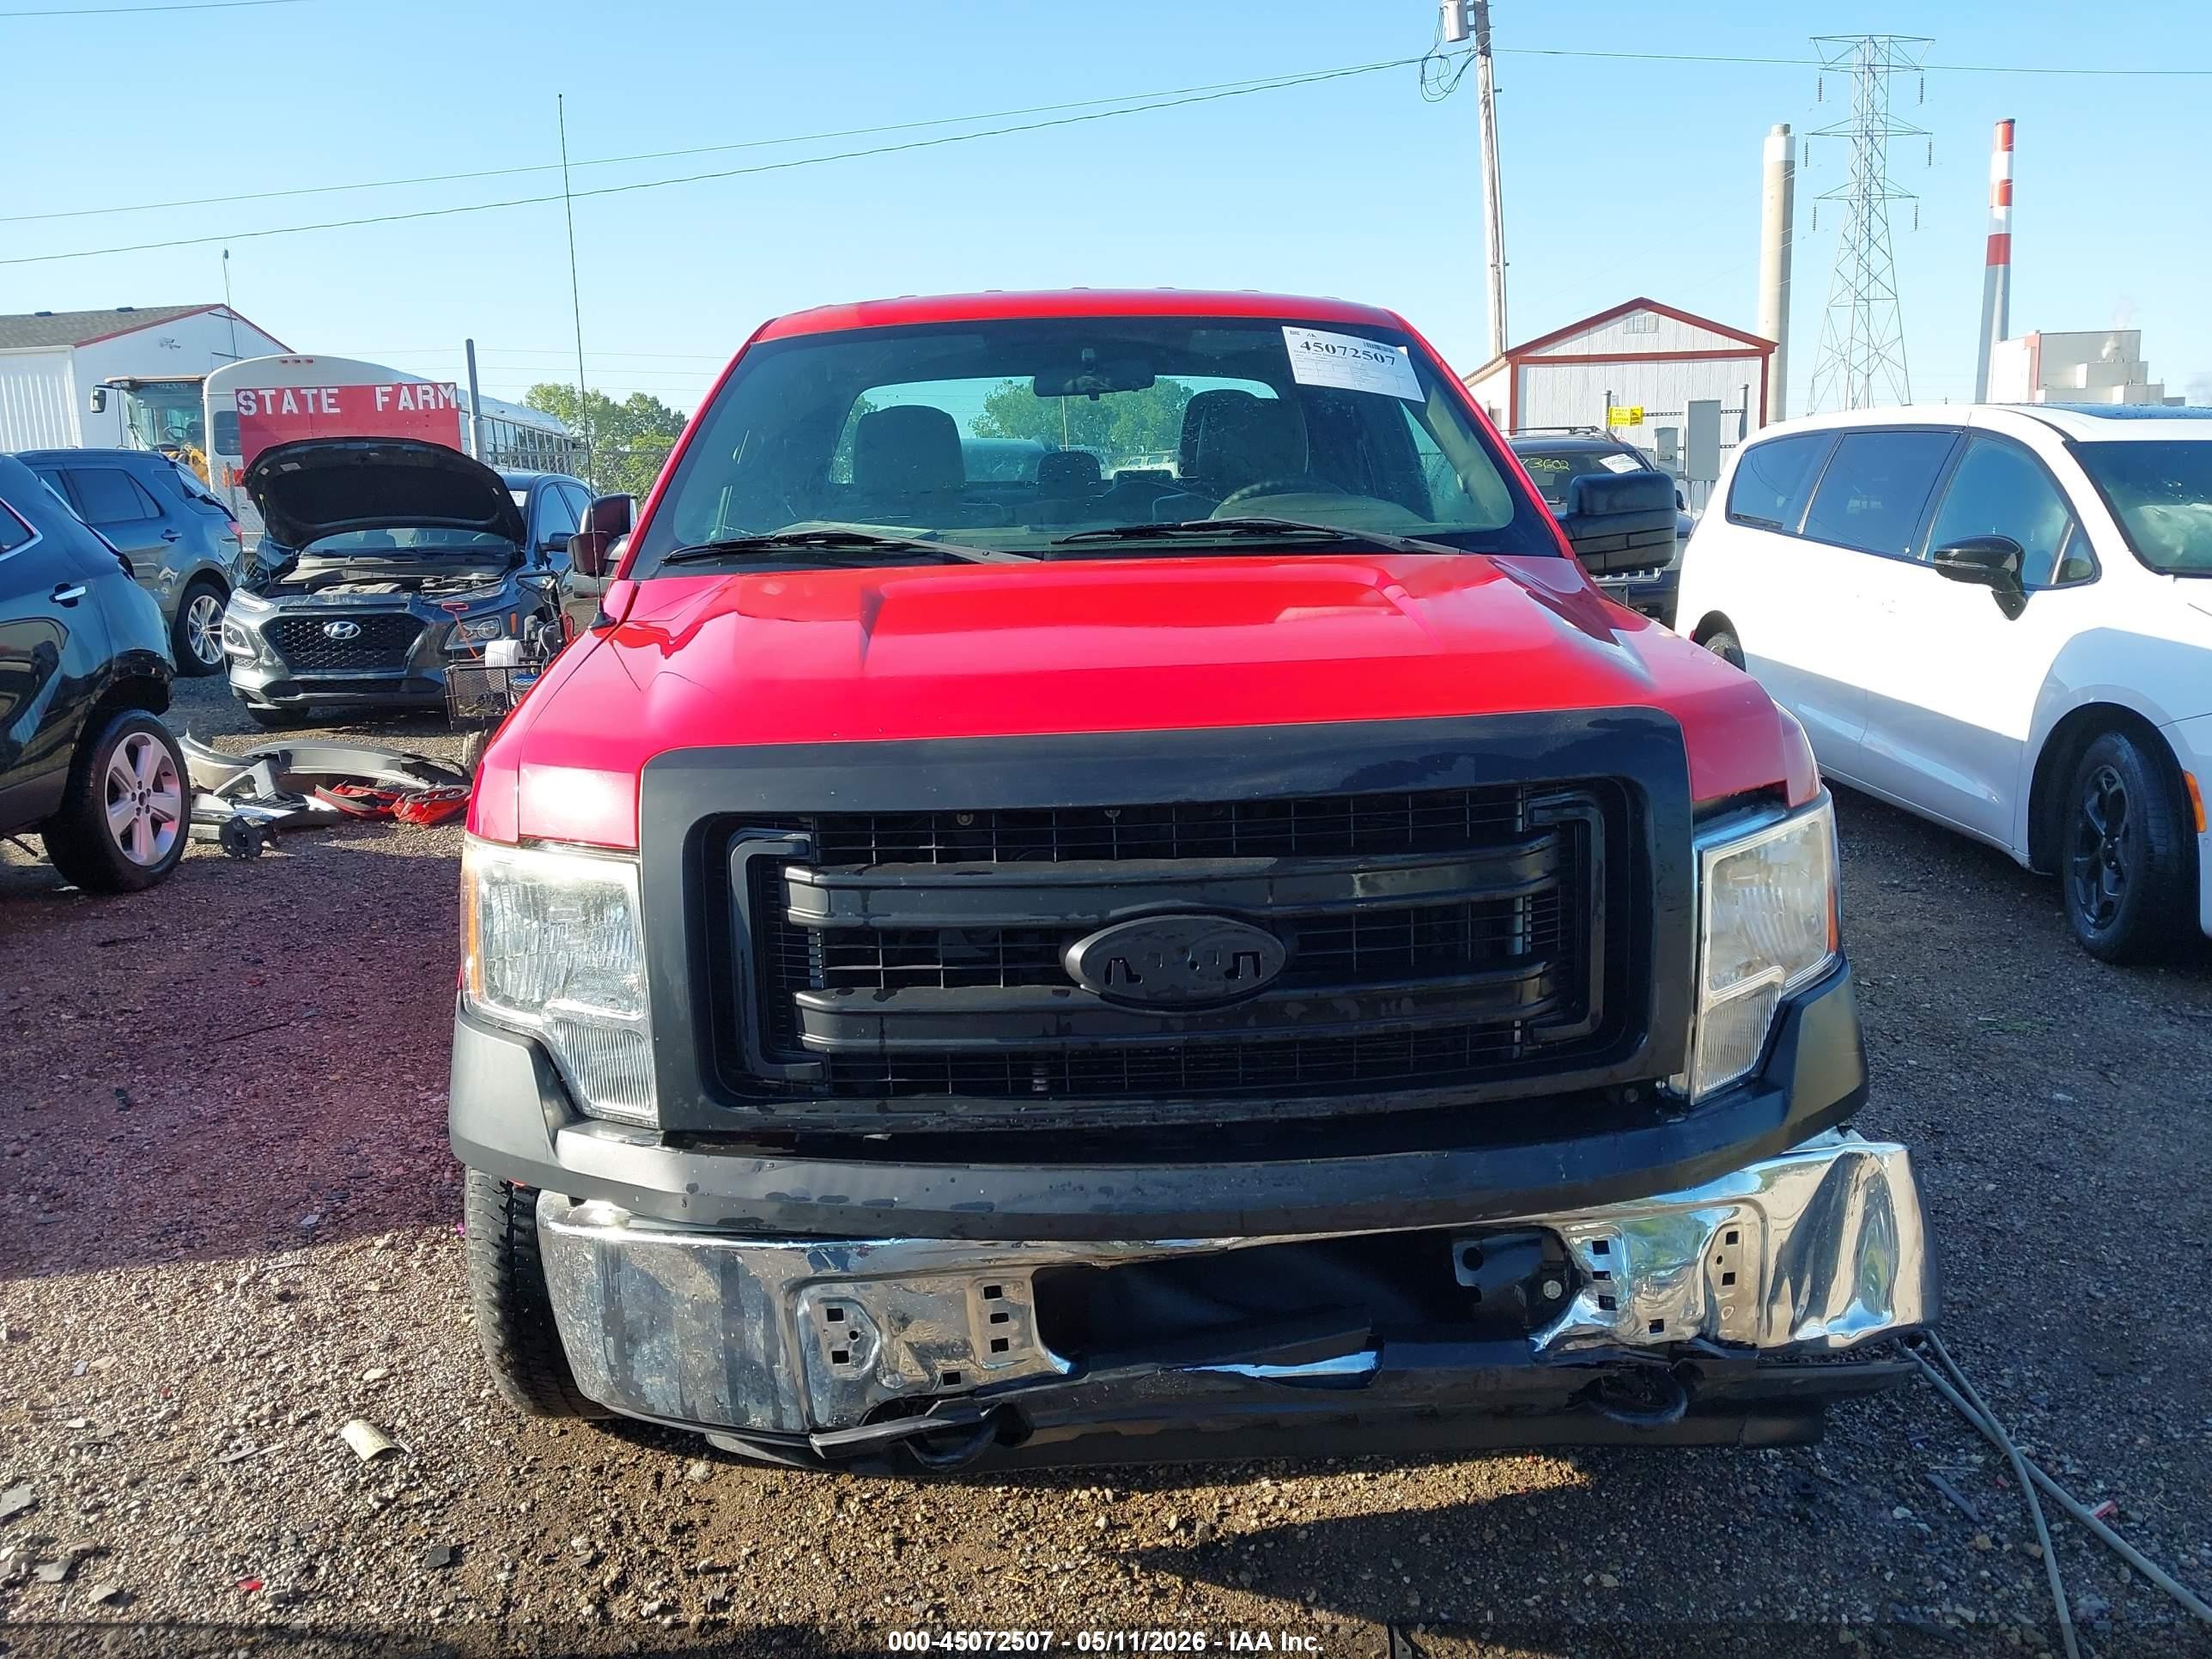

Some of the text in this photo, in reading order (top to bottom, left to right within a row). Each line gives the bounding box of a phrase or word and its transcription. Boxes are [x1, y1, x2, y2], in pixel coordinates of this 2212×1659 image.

[1299, 341, 1395, 366] 45072507
[237, 384, 457, 416] STATE FARM
